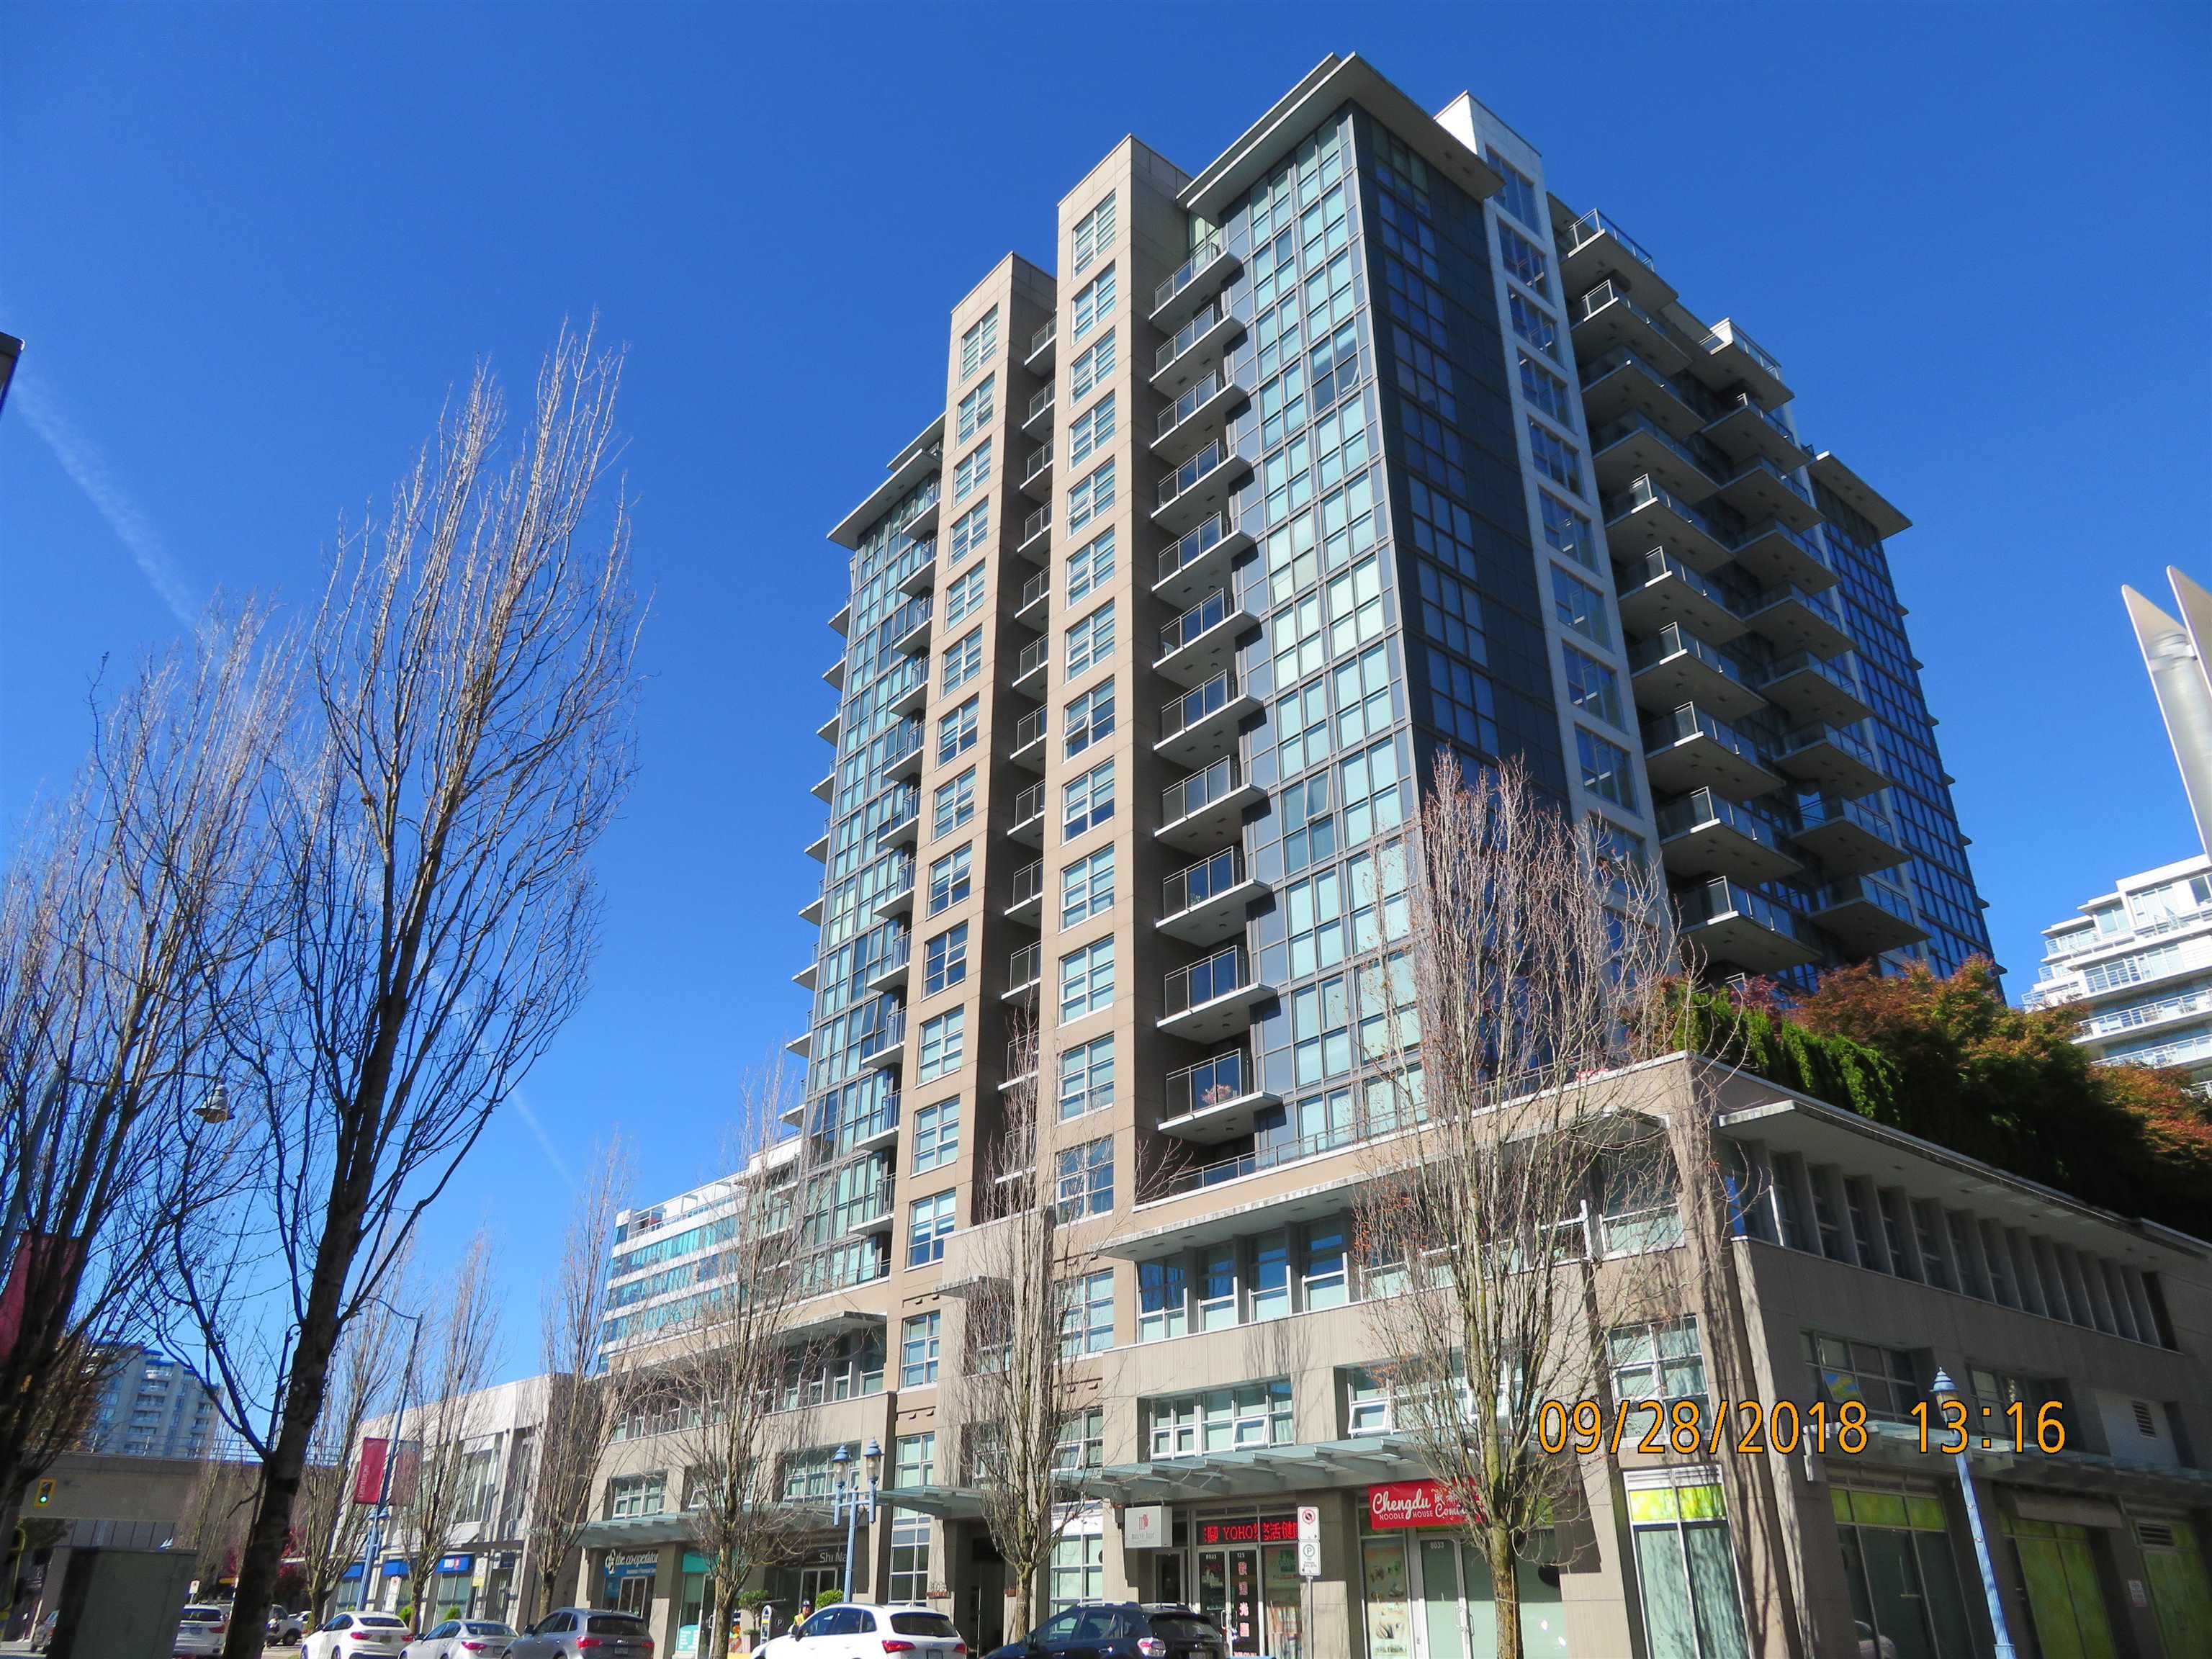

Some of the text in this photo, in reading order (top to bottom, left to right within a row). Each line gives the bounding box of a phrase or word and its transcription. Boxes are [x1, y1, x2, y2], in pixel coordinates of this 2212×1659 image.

[1372, 1488, 1431, 1520] Chengdu
[1379, 1510, 1433, 1521] NOODLE HOUSE
[1223, 1524, 1253, 1540] YOHO
